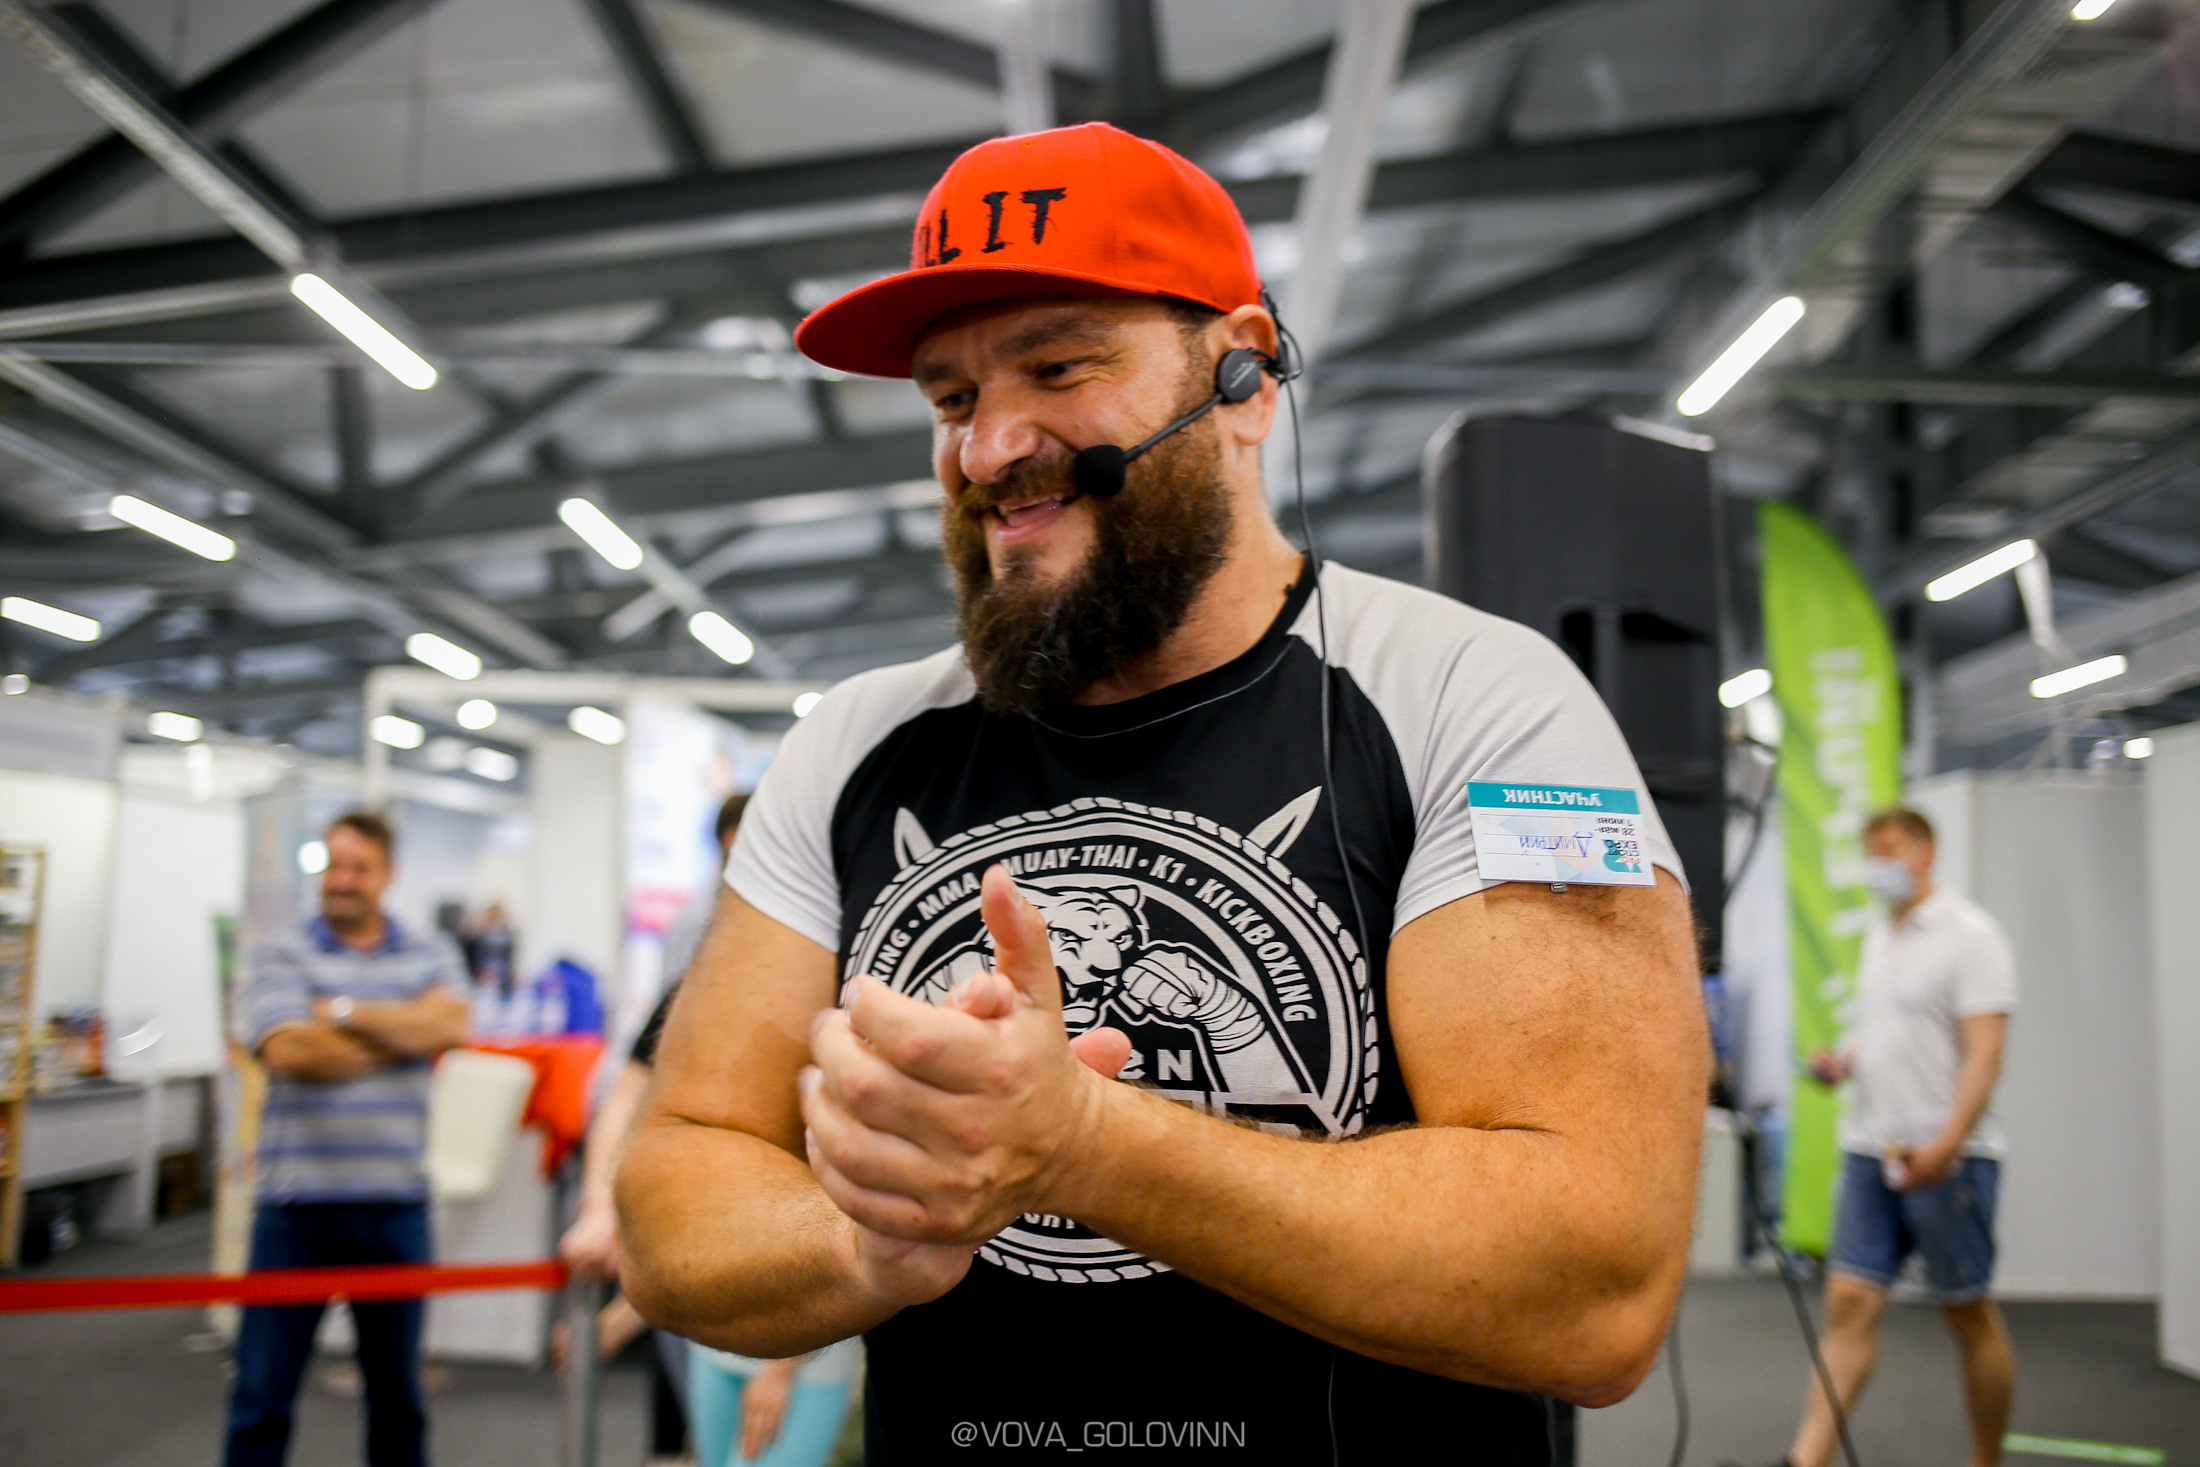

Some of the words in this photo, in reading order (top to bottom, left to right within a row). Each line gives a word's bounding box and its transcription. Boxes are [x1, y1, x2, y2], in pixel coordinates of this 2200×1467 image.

[981, 187, 1067, 254] IT
[1502, 788, 1603, 807] УЧАСТНИК
[916, 871, 981, 920] MMA
[1001, 844, 1138, 876] MUAY-THAI
[1149, 854, 1187, 884] K1
[1194, 878, 1318, 1023] KICKBOXING
